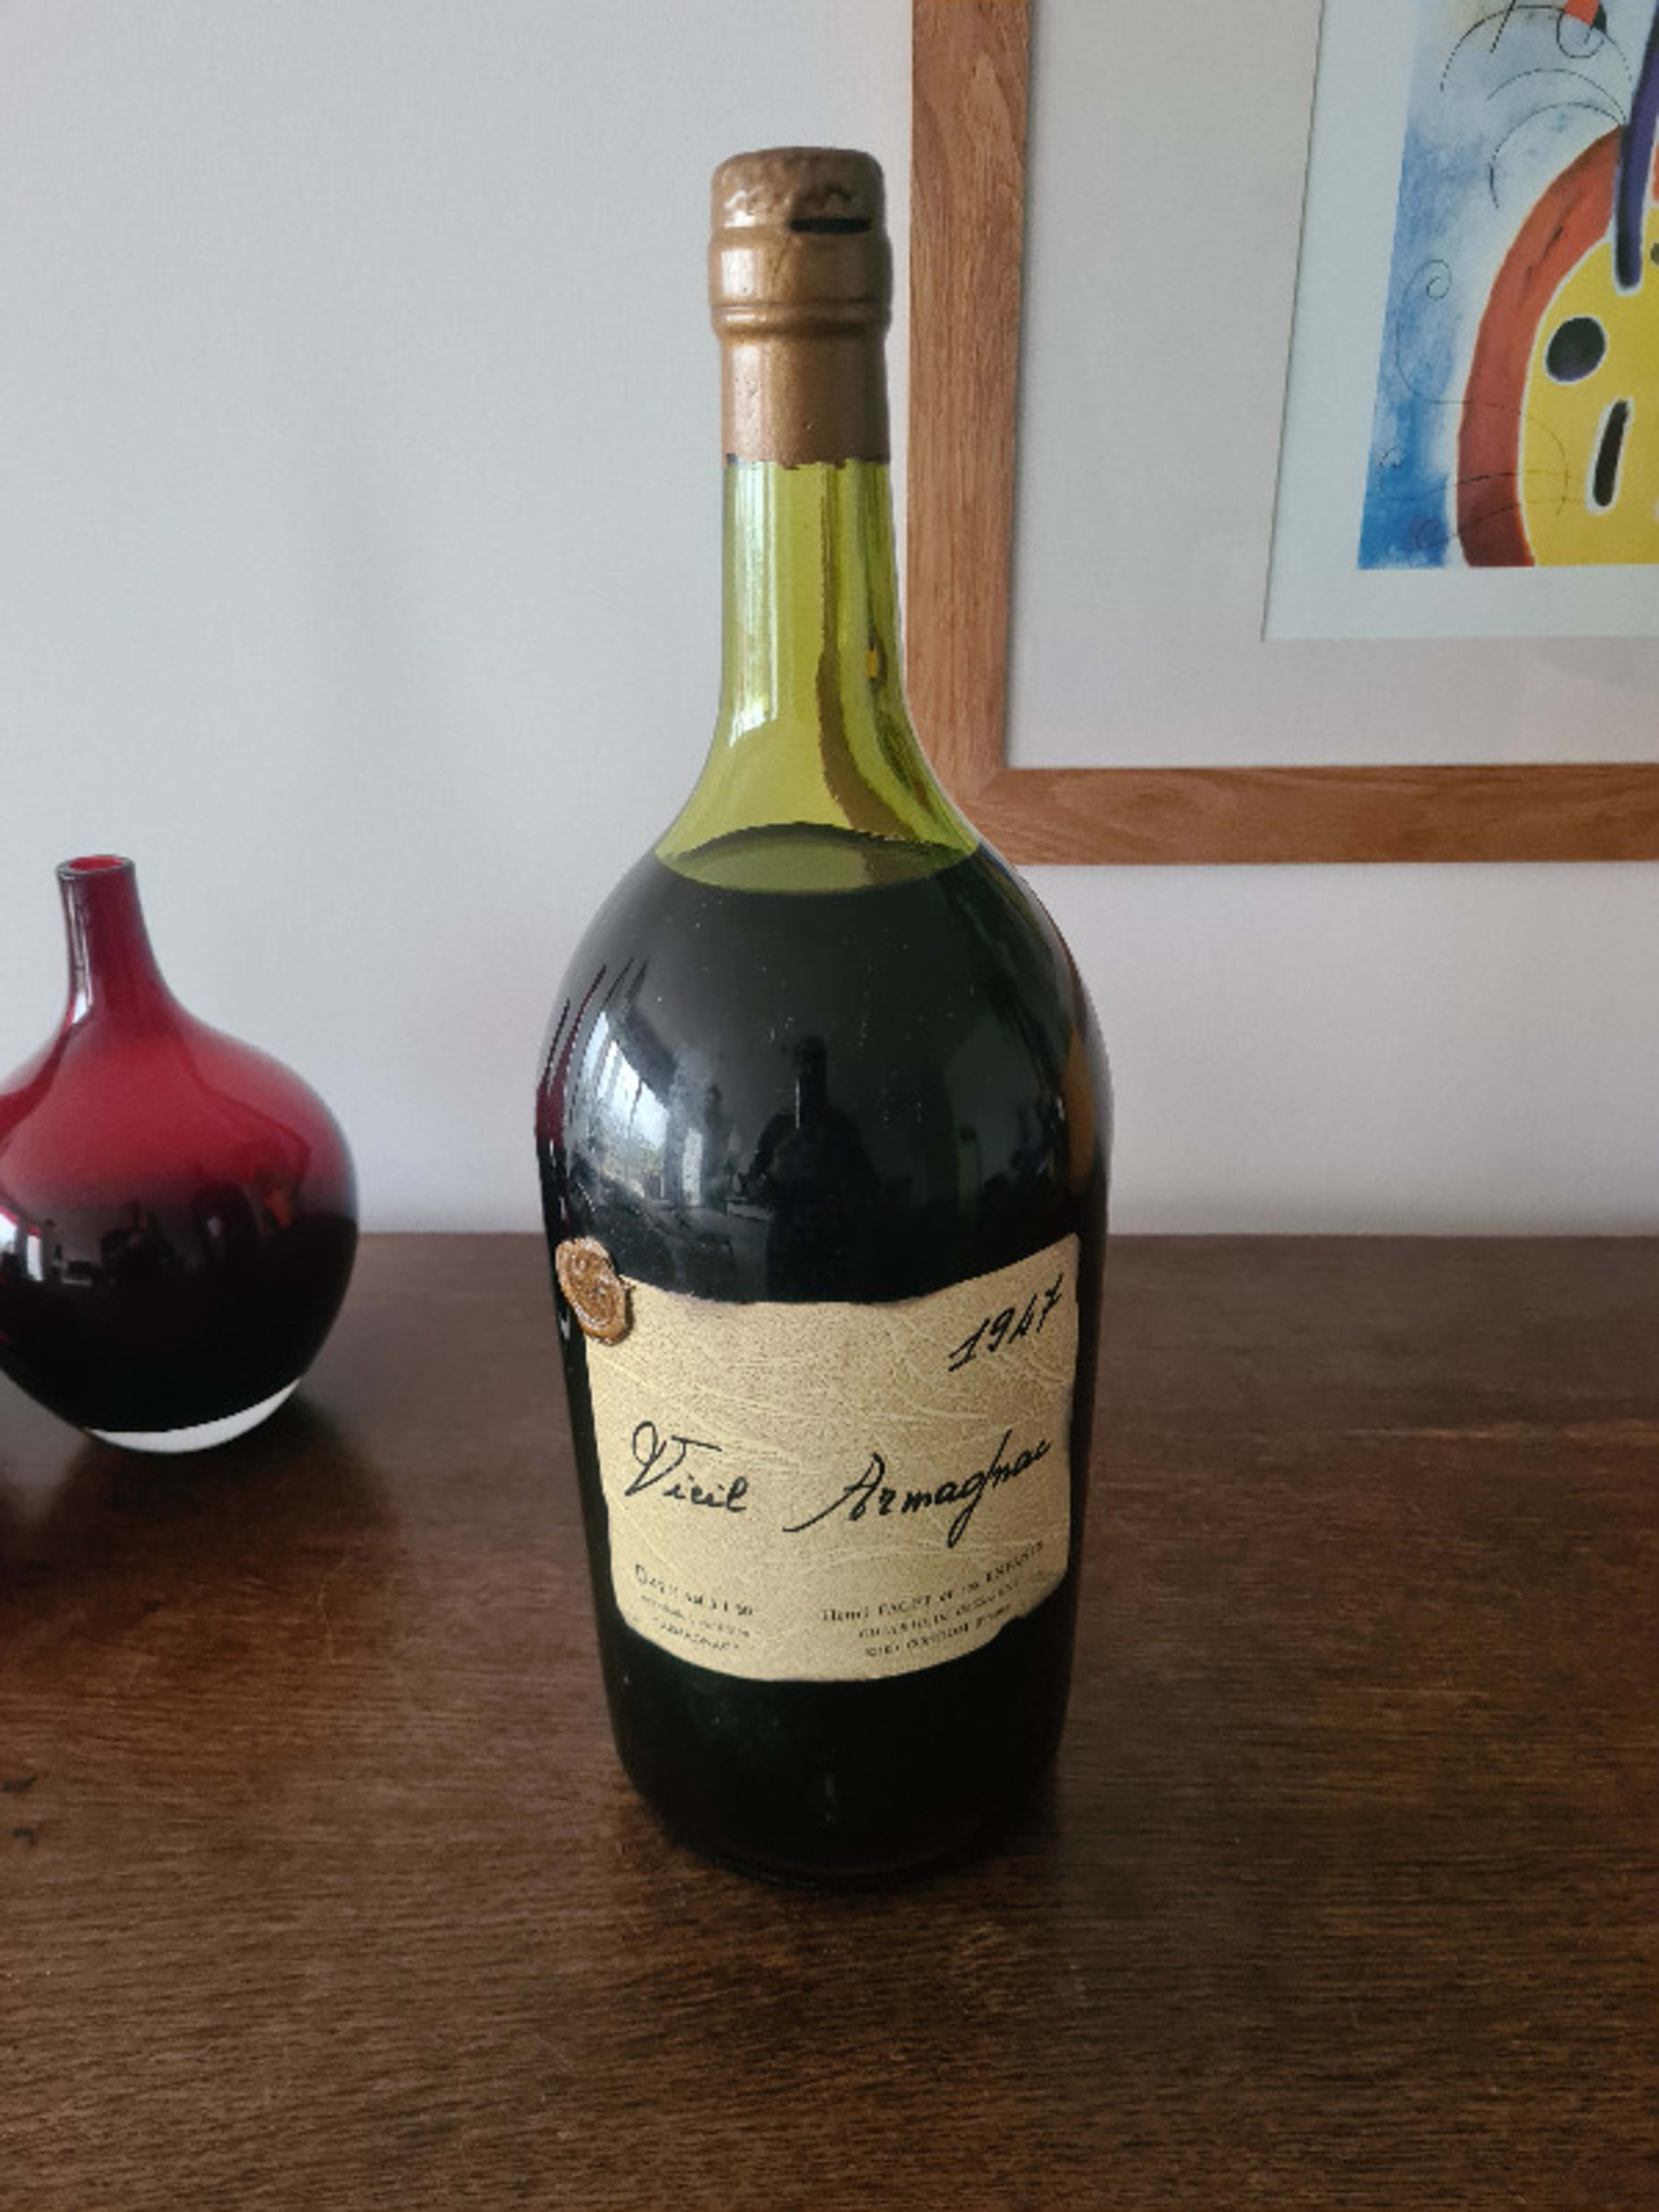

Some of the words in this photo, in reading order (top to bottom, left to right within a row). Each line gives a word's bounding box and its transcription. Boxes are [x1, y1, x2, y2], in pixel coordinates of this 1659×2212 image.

[948, 1272, 1064, 1372] 1947
[625, 1421, 748, 1513] Vieil
[782, 1429, 1051, 1549] Armagnac
